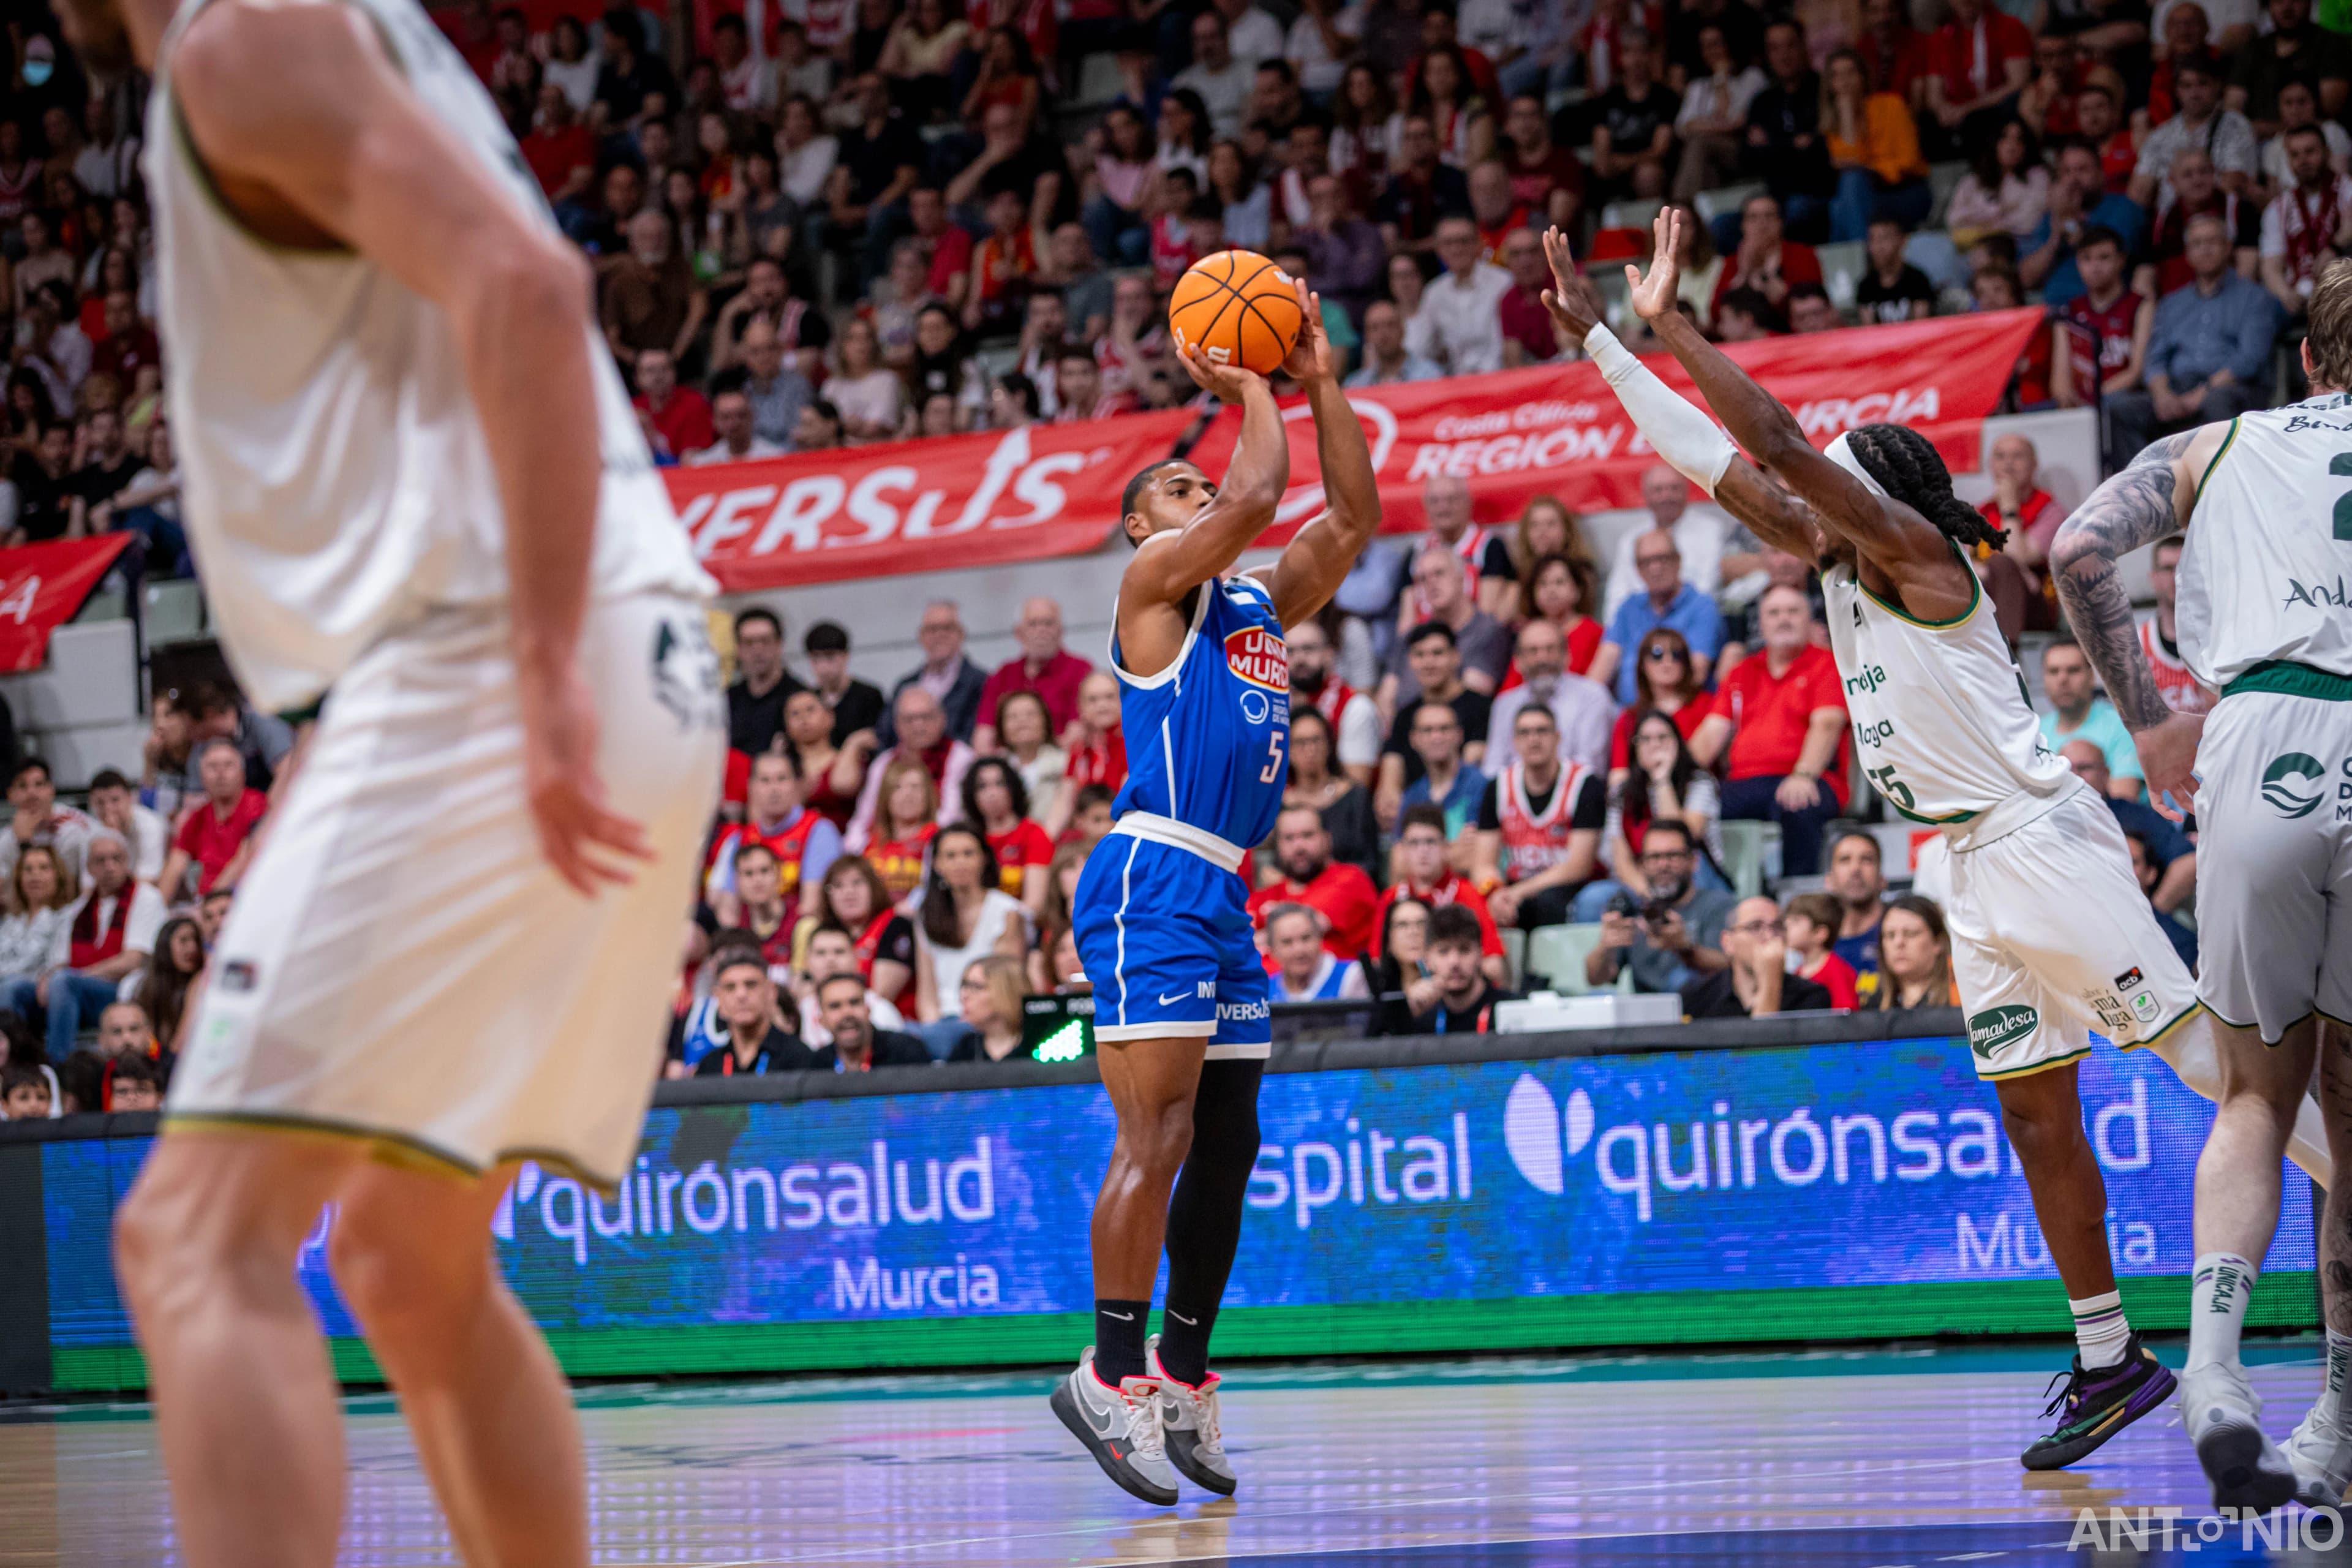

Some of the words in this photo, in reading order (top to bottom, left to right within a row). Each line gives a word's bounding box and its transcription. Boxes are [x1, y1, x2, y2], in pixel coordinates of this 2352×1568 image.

[1796, 386, 1940, 436] RCIA
[1259, 731, 1284, 783] 5
[1868, 764, 1915, 810] 5
[2119, 976, 2139, 990] acb
[1968, 1009, 2035, 1045] famadesa
[1246, 1112, 1472, 1231] spital
[1595, 1076, 2153, 1223] quirónsad
[540, 1135, 995, 1267] quirónsalud
[1956, 1207, 2155, 1272] Muia
[833, 1254, 1000, 1313] Murcia
[2209, 1265, 2239, 1314] UNICAJA
